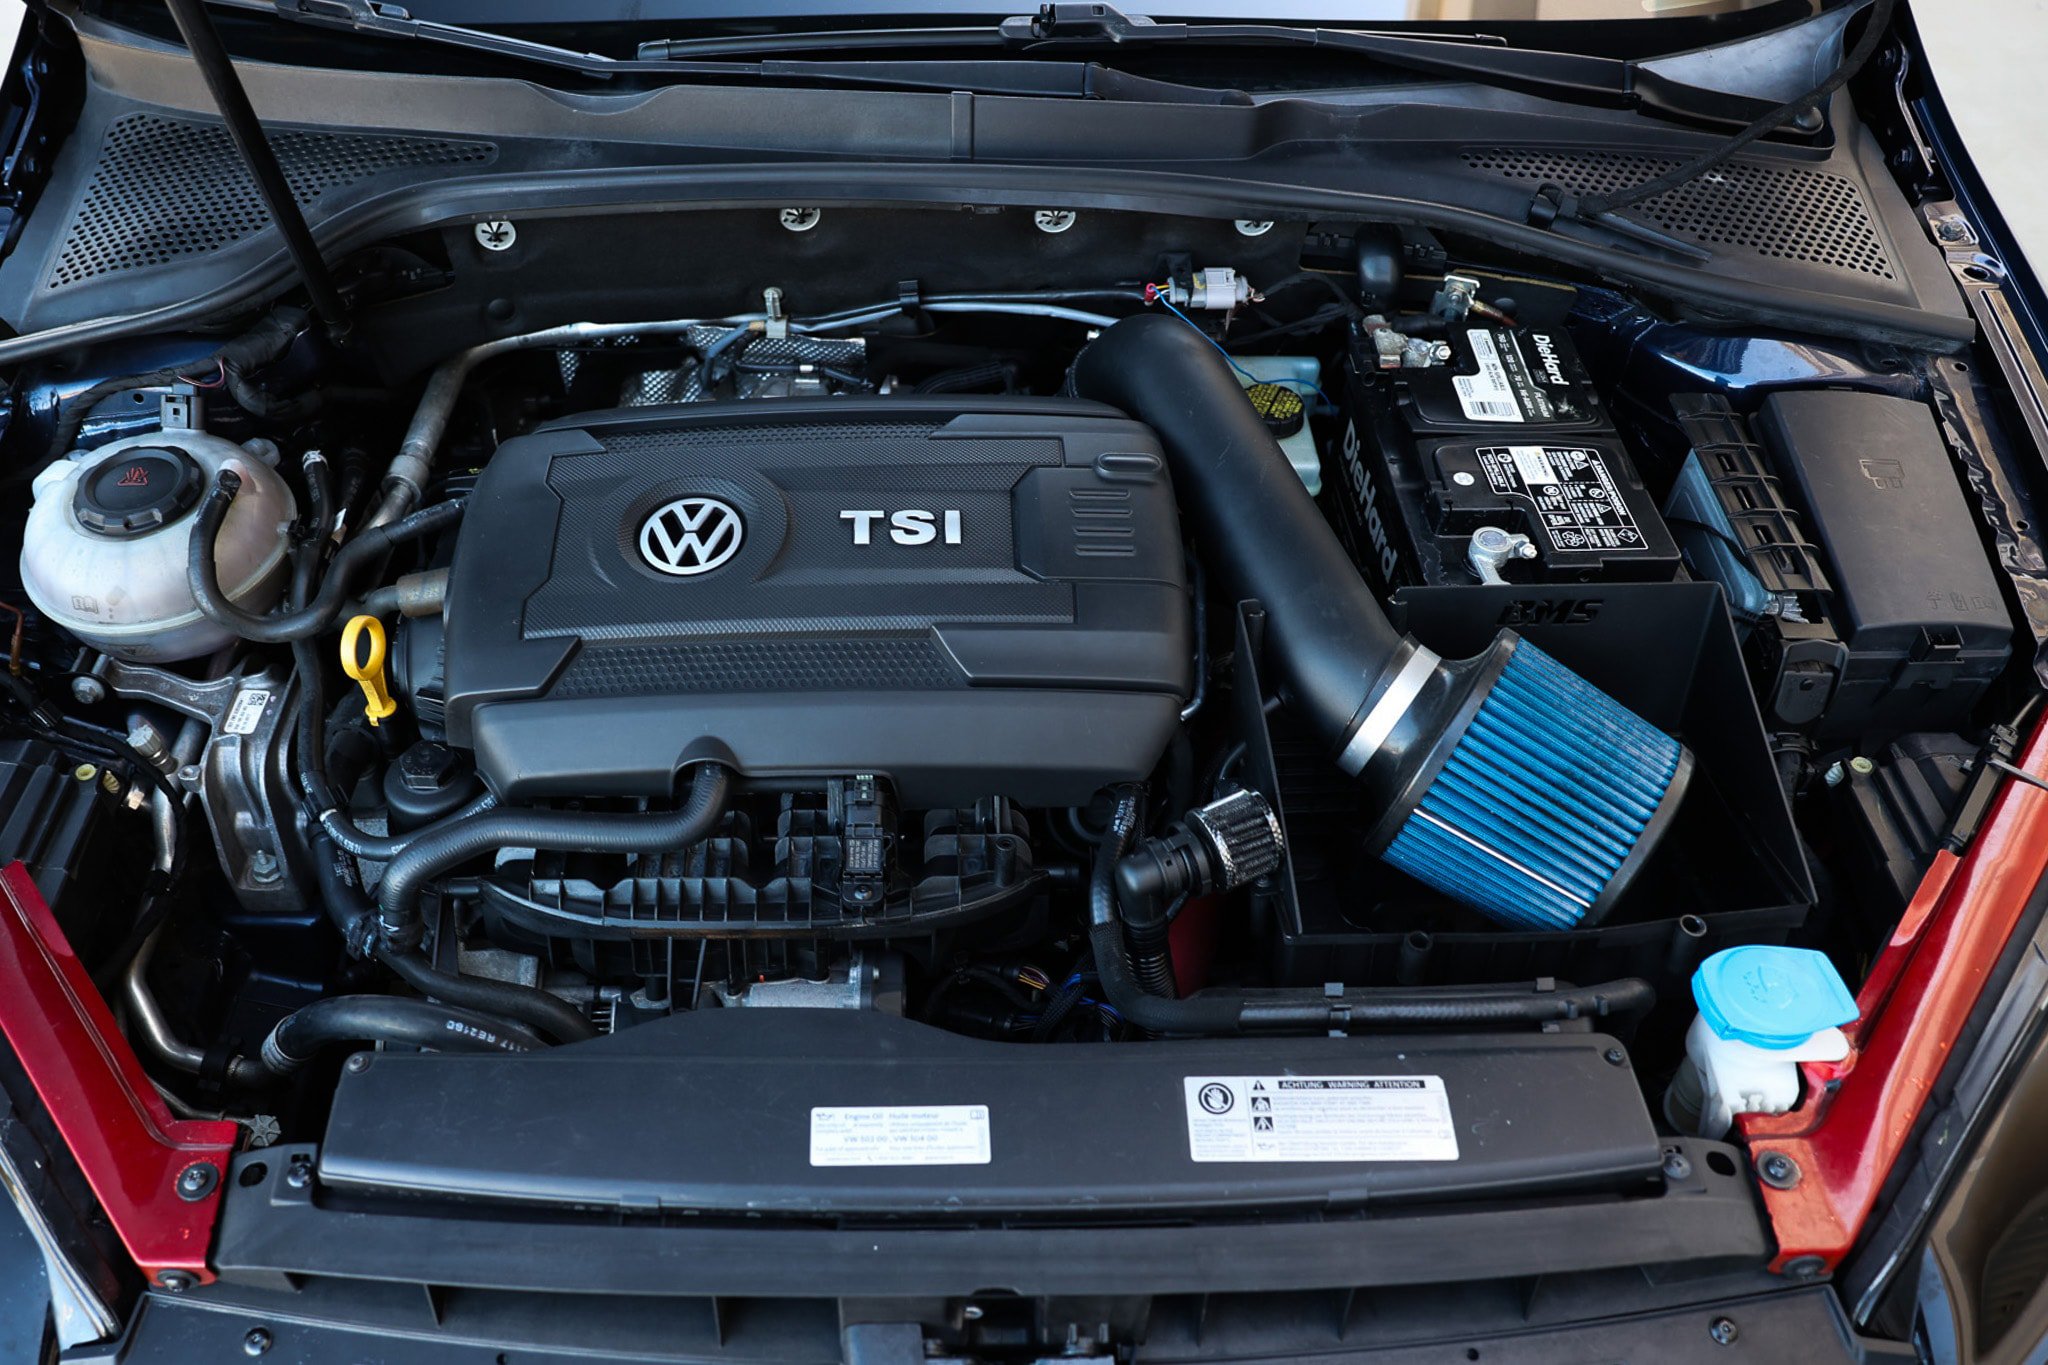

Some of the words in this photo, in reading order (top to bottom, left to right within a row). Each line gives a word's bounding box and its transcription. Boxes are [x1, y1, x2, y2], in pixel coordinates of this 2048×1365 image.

[1532, 333, 1570, 386] DieHard
[1534, 391, 1551, 418] PLATINUM
[1343, 417, 1398, 584] DieHard
[839, 509, 963, 546] TSI
[1281, 1081, 1324, 1090] ACHTUNG
[1327, 1080, 1369, 1089] WARNING
[1372, 1080, 1421, 1089] ATTENTION
